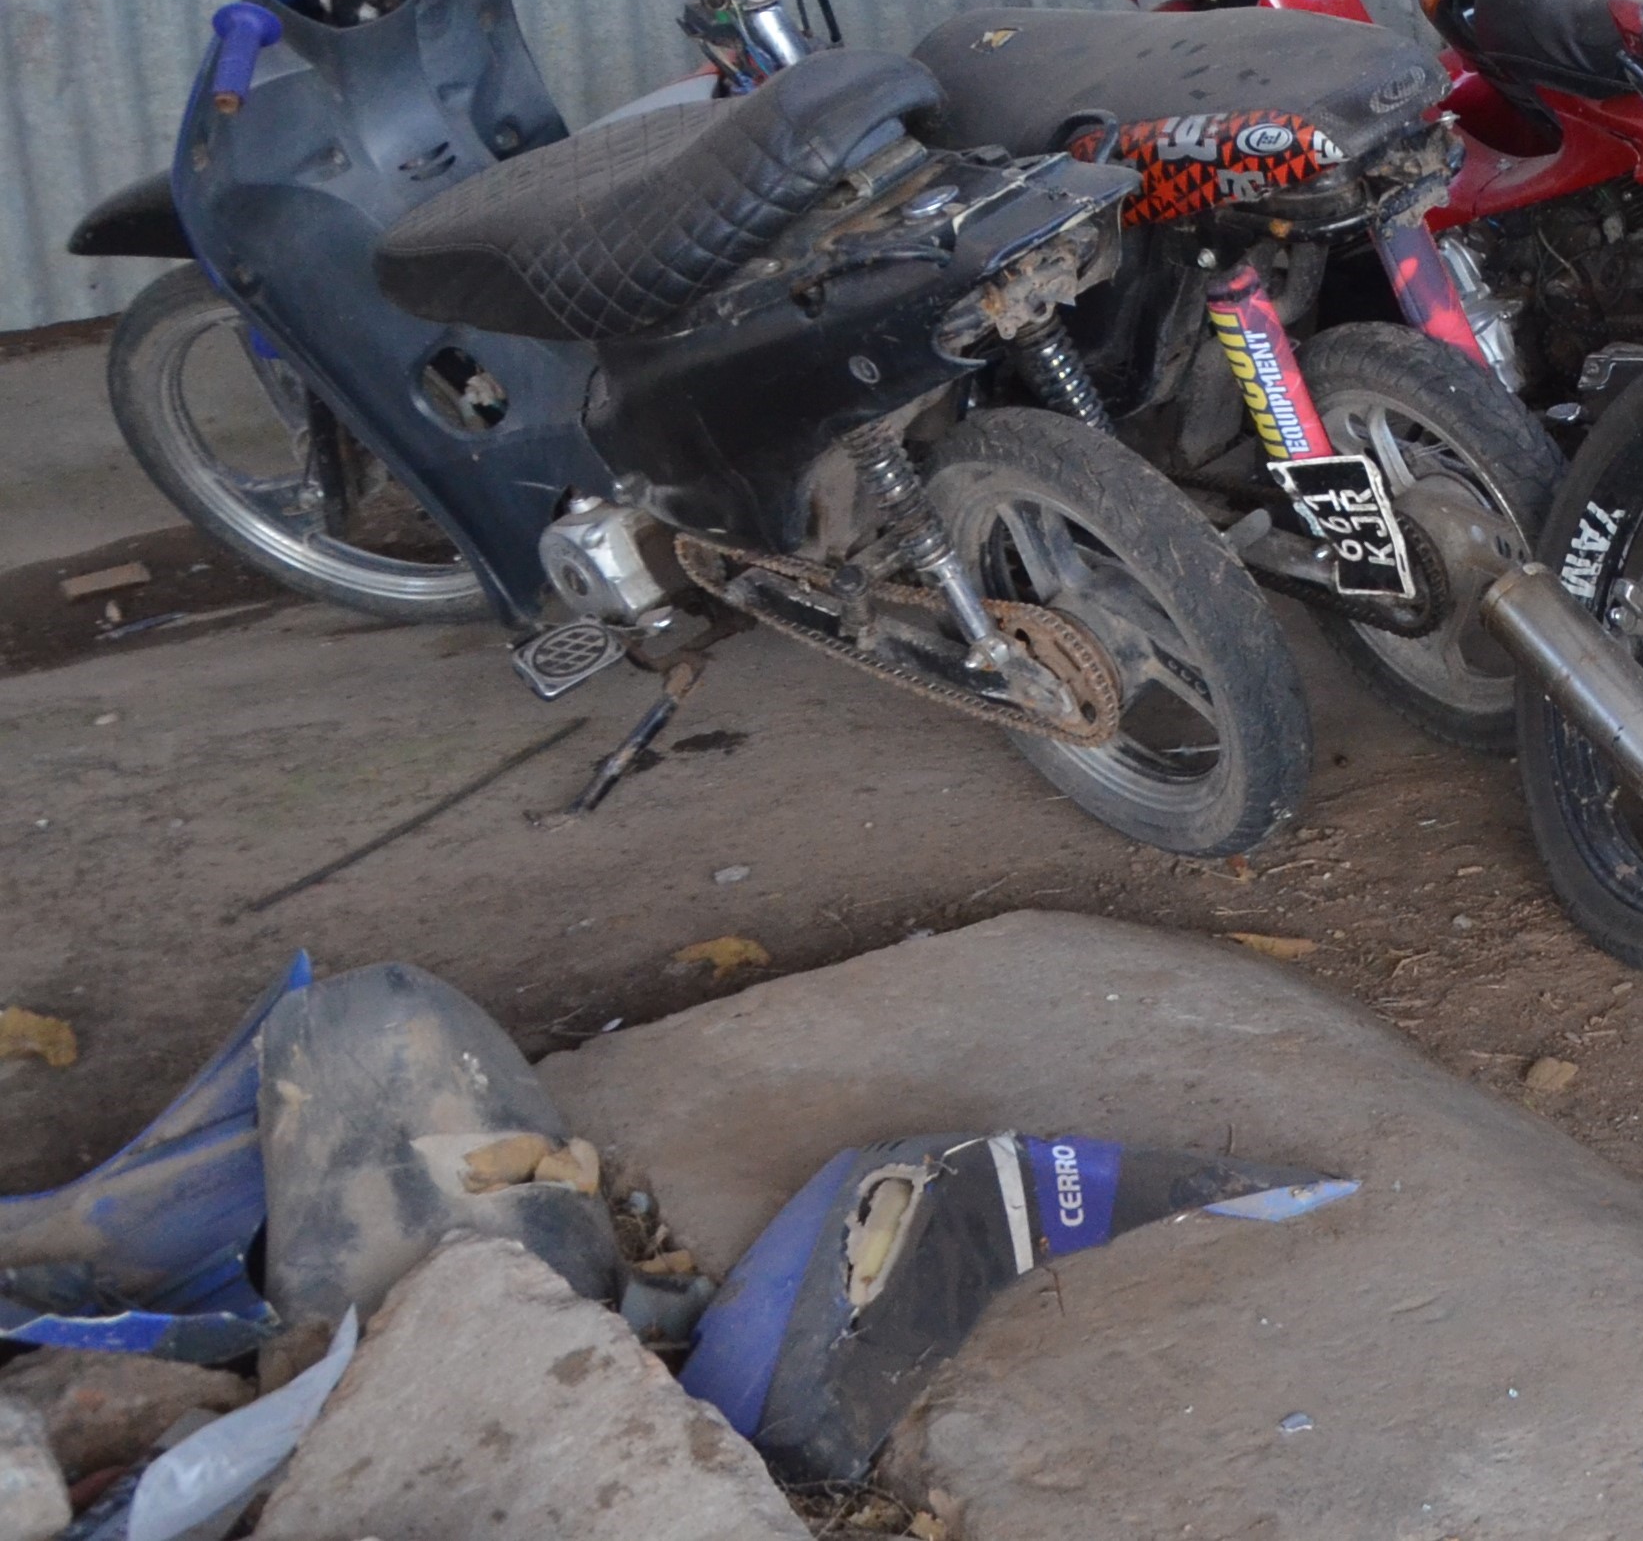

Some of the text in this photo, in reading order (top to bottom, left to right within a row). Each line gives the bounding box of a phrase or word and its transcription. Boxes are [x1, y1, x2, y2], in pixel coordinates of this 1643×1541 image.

[1244, 329, 1311, 454] EQUIPMENT
[1303, 488, 1364, 563] 661
[1338, 487, 1397, 567] KJR
[1051, 1144, 1085, 1227] CERRO
